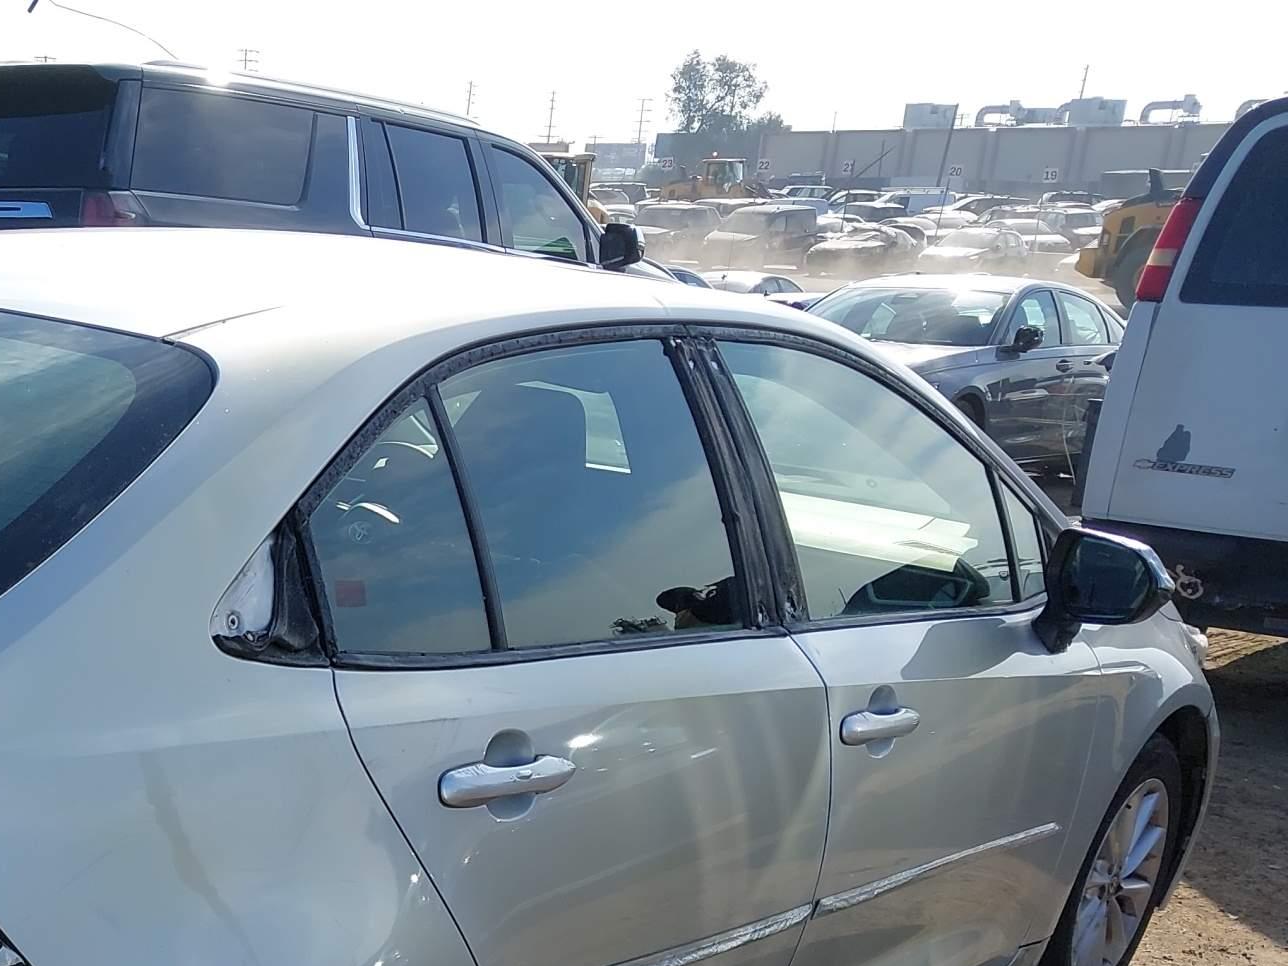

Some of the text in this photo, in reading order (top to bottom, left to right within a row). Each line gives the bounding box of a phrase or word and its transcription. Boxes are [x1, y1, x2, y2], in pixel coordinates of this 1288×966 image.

[662, 160, 673, 168] 23
[759, 161, 770, 170] 22
[950, 167, 962, 176] 20
[1044, 171, 1057, 181] 19
[1153, 461, 1235, 478] EXPRESS
